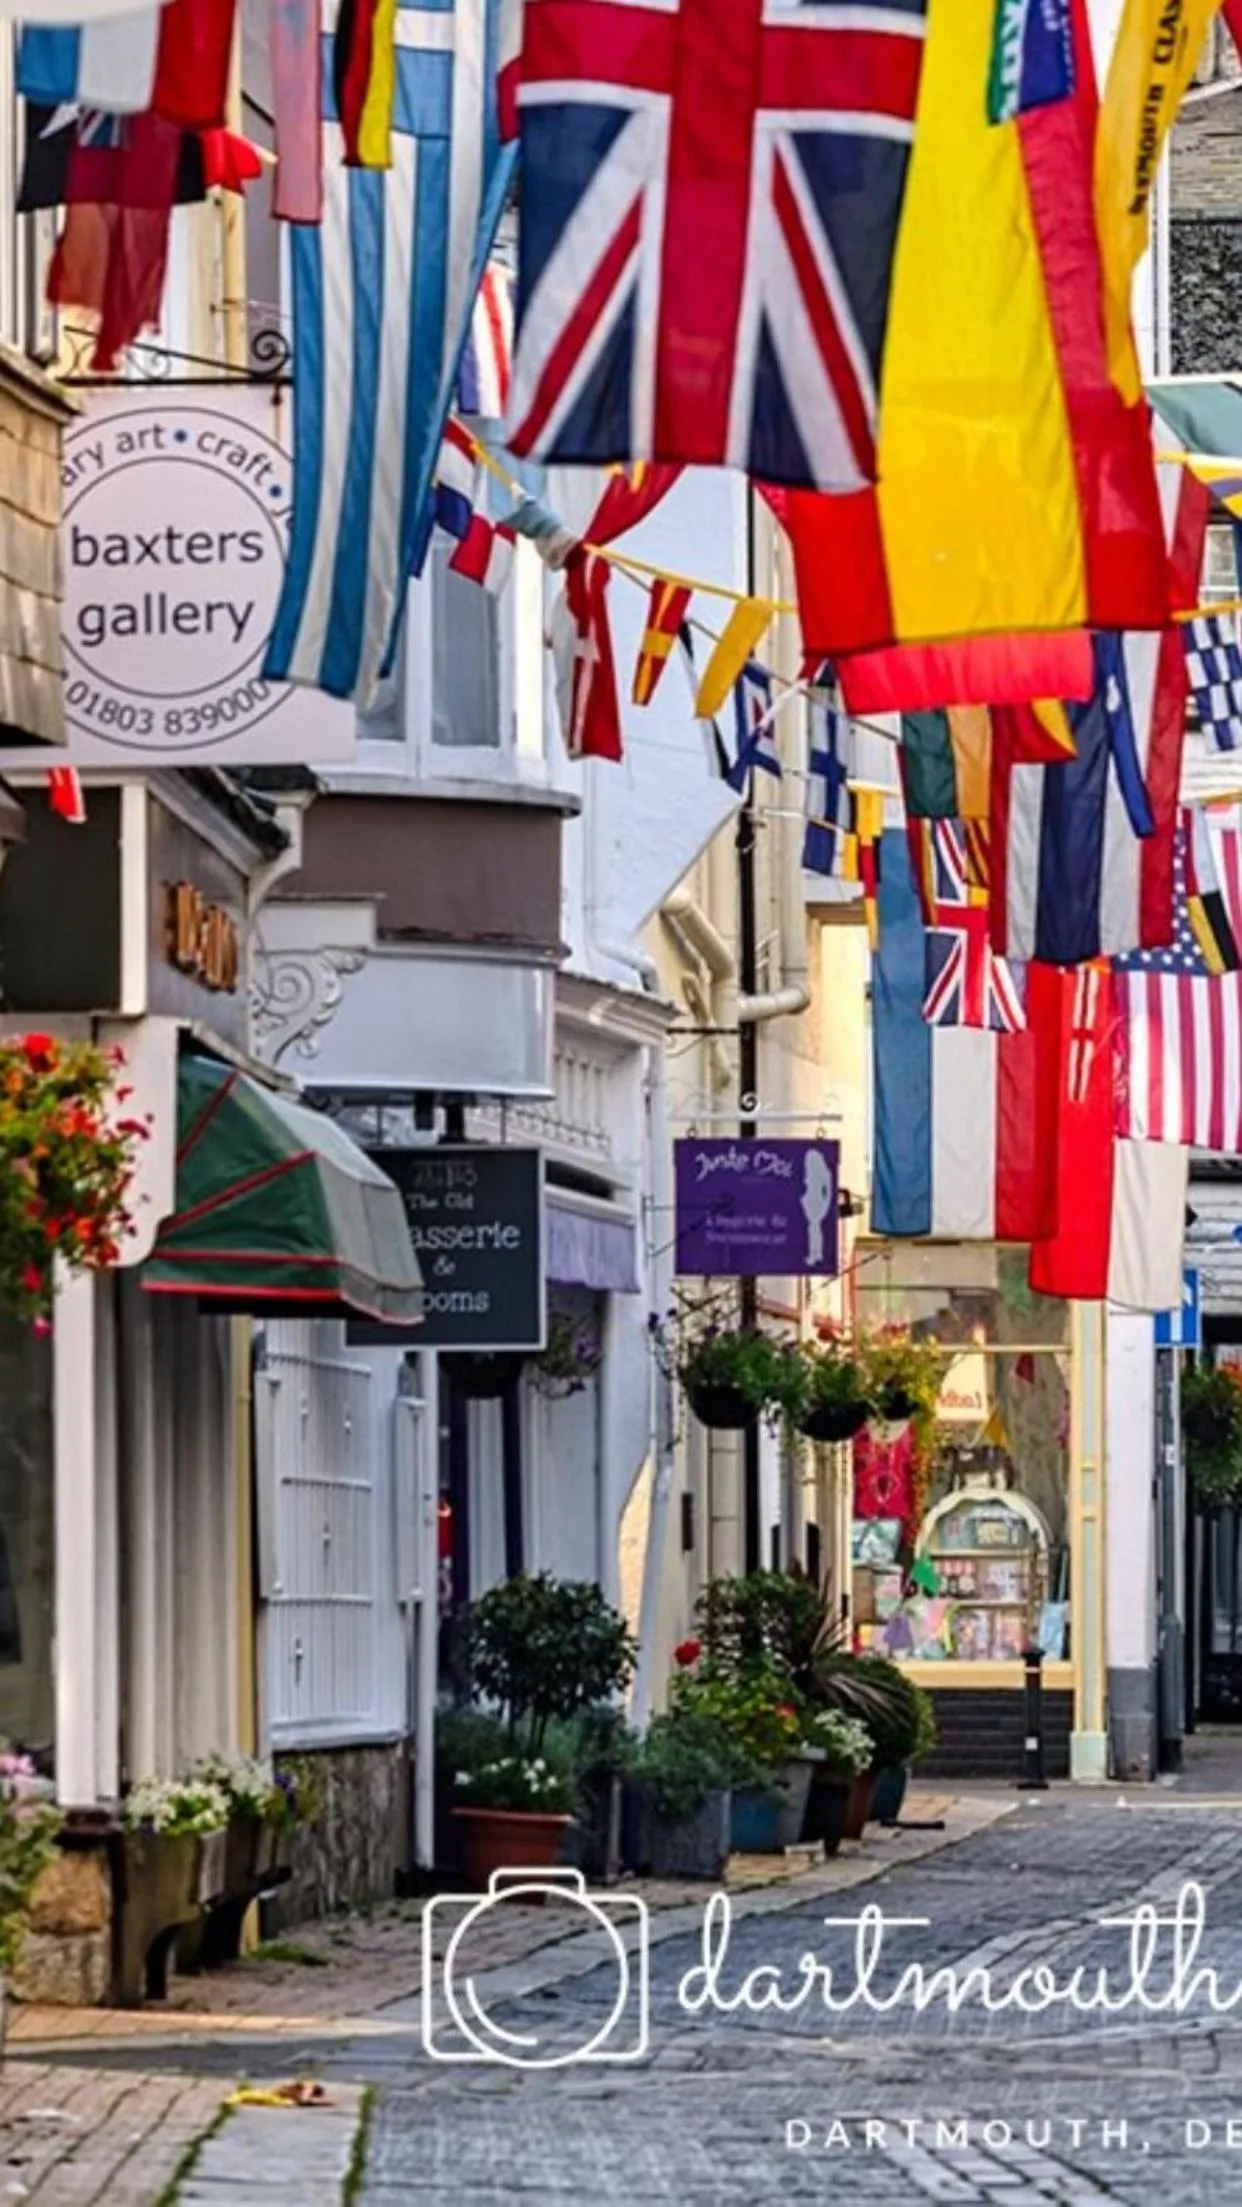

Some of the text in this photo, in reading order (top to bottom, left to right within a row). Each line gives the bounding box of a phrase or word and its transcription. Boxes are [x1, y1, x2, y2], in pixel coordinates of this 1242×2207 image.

[116, 423, 166, 453] art
[196, 429, 277, 486] craft
[71, 526, 264, 568] baxters
[77, 593, 255, 647] gallery
[65, 678, 271, 738] 01803 839000
[433, 1255, 456, 1277] &
